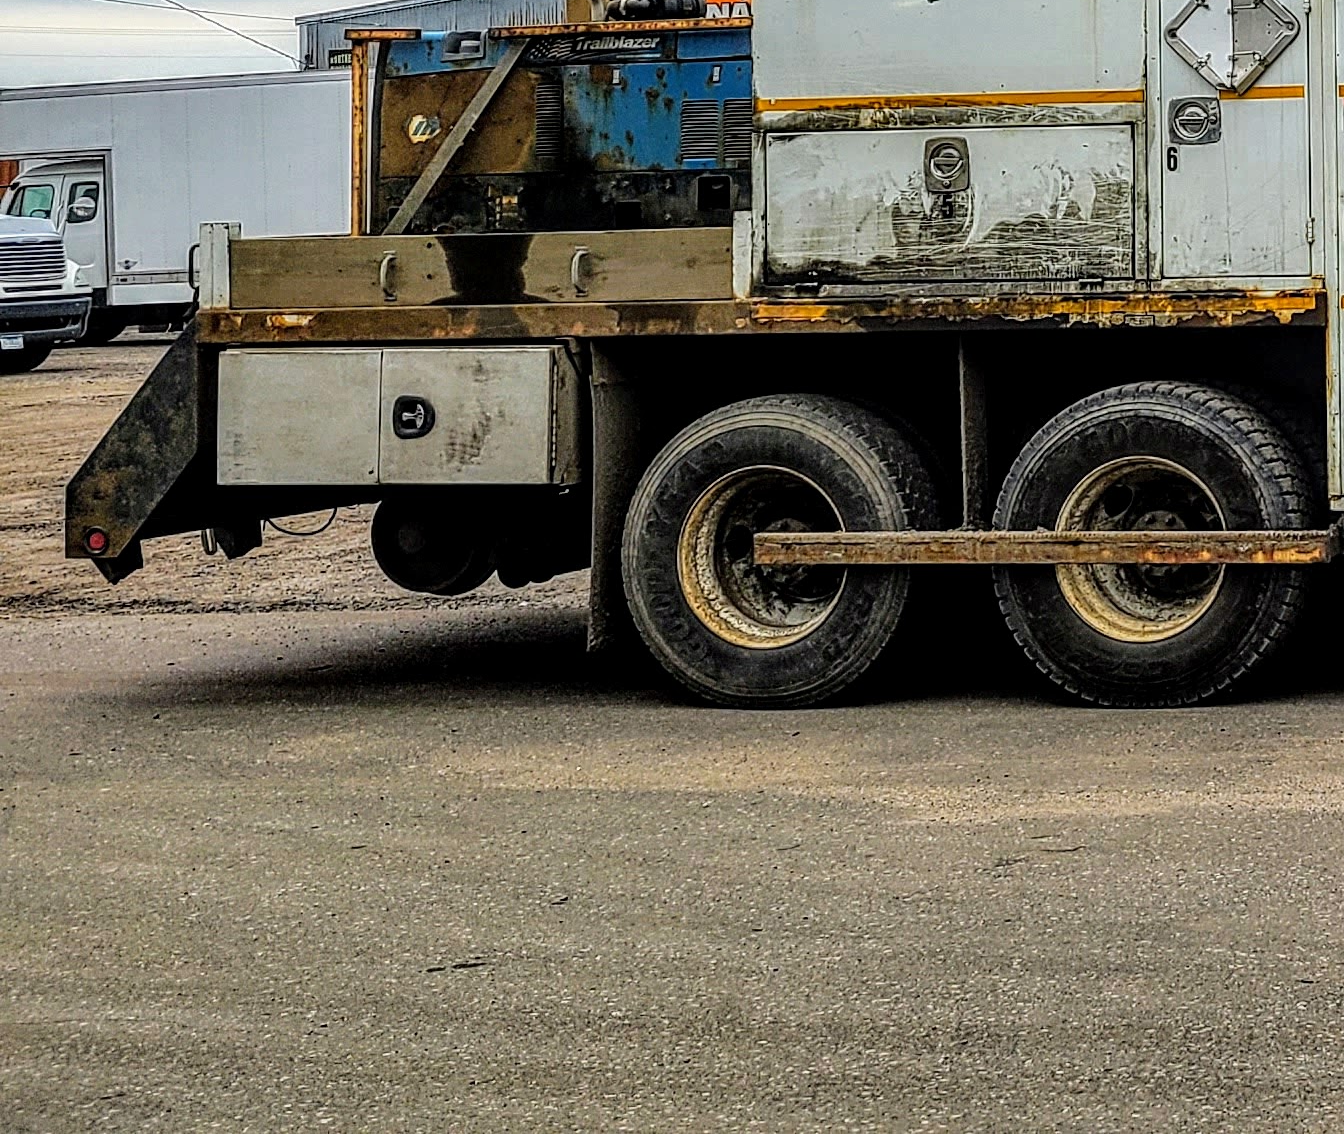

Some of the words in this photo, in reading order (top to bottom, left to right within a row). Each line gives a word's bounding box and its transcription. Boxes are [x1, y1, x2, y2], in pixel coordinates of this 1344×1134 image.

[576, 35, 660, 51] Trailblazer
[1166, 146, 1178, 172] 6
[940, 194, 953, 219] 5
